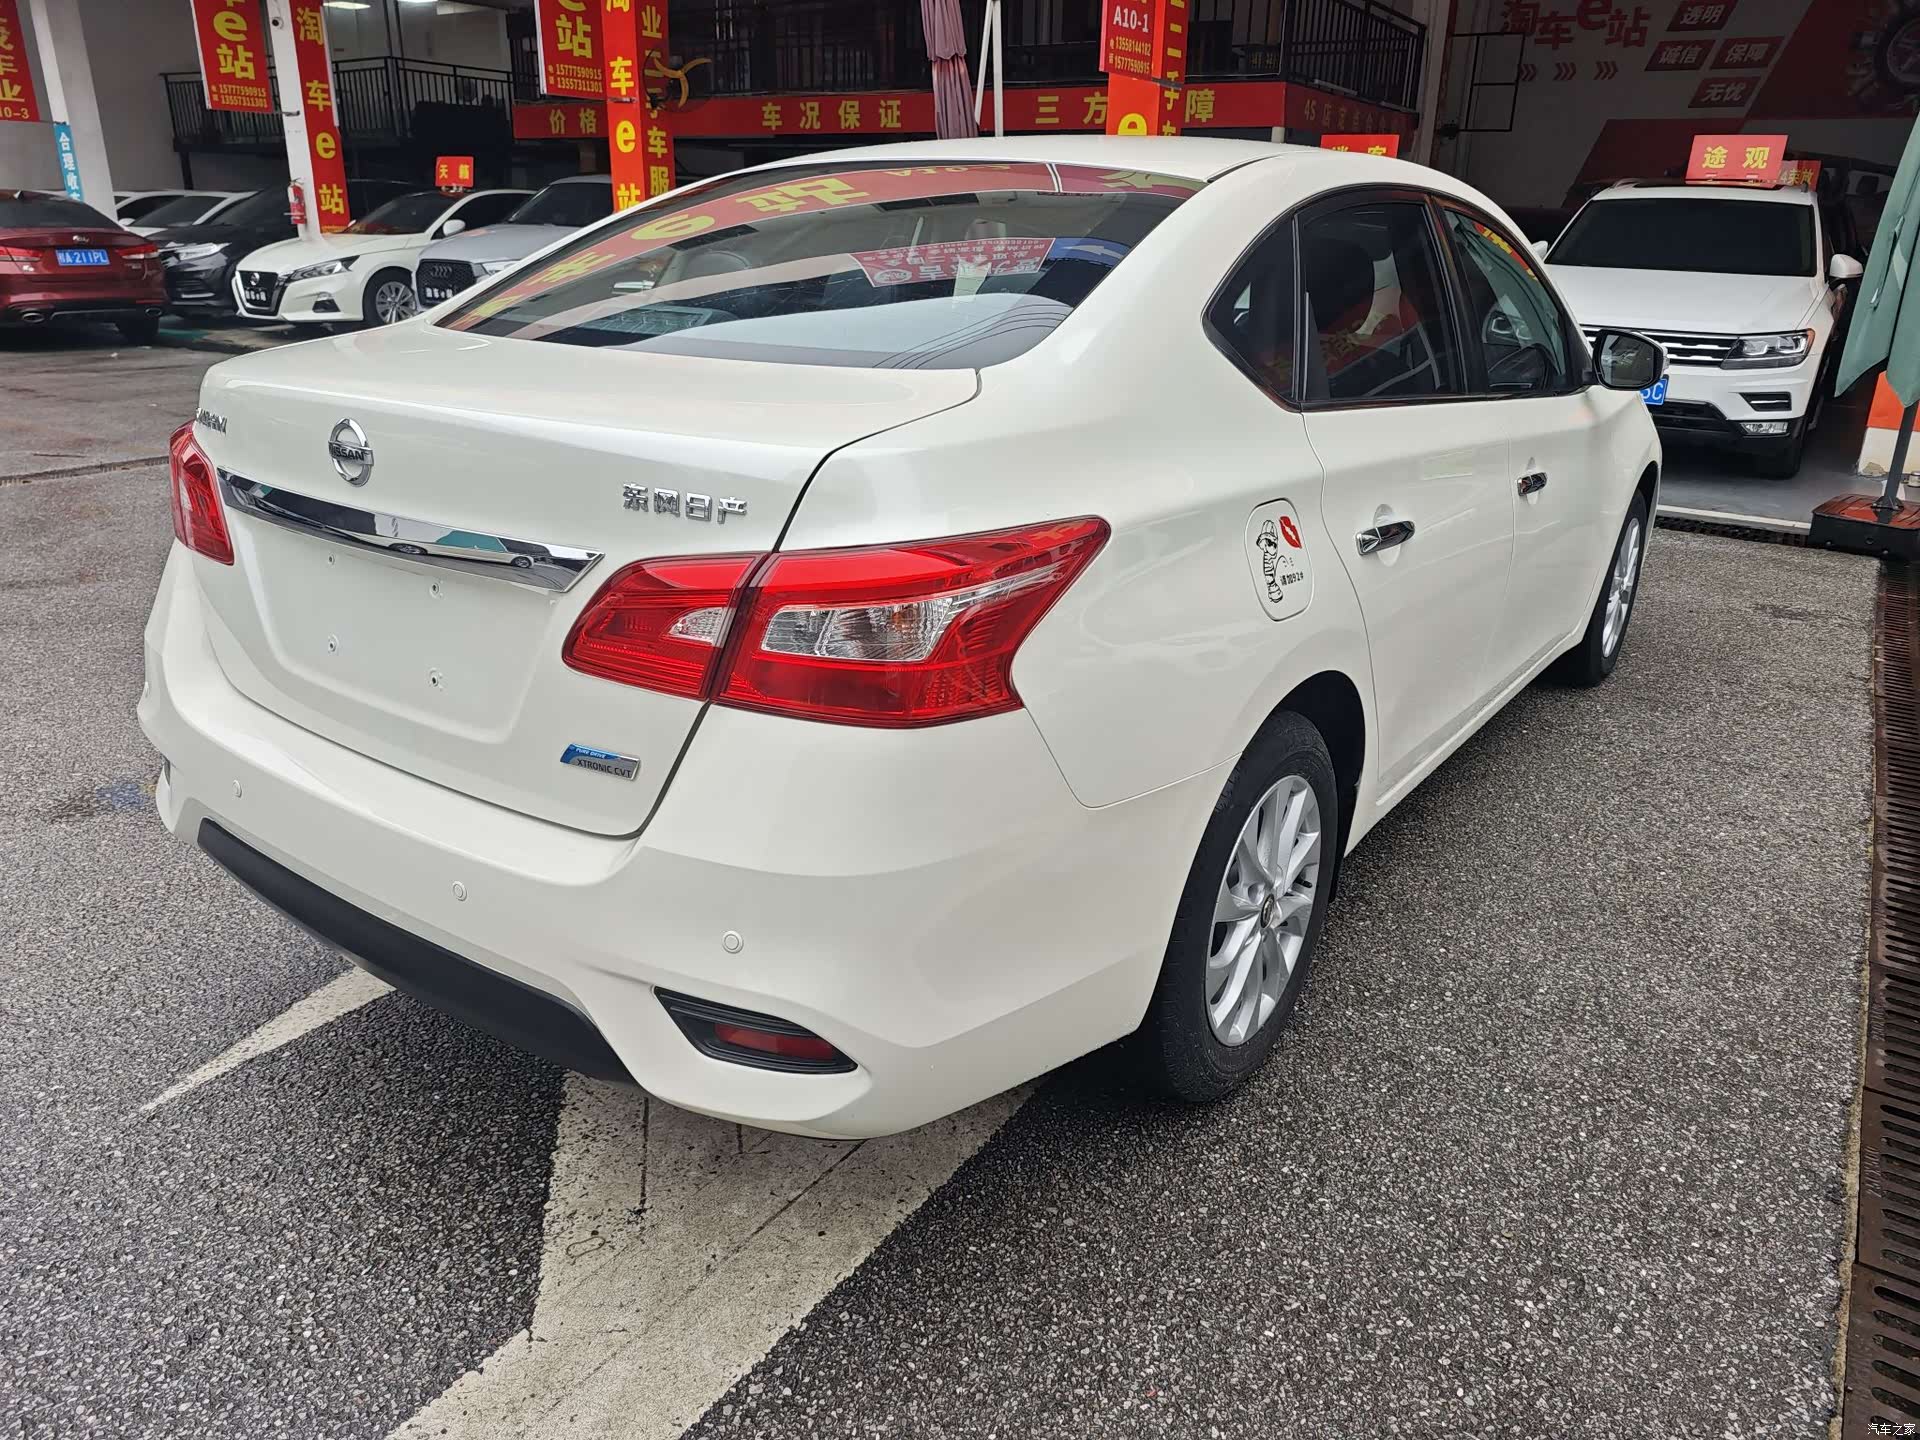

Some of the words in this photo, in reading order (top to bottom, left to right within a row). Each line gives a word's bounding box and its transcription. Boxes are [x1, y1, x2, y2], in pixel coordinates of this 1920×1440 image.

[1113, 5, 1149, 33] A10-1
[1679, 4, 1725, 25] 透明
[213, 0, 255, 80] e站
[297, 7, 345, 215] 淘车e站
[761, 102, 901, 131] 车况保证
[1702, 145, 1770, 169] 途观
[329, 444, 367, 461] NISSAN
[577, 758, 612, 774] XTRONIC
[614, 767, 632, 778] CVT
